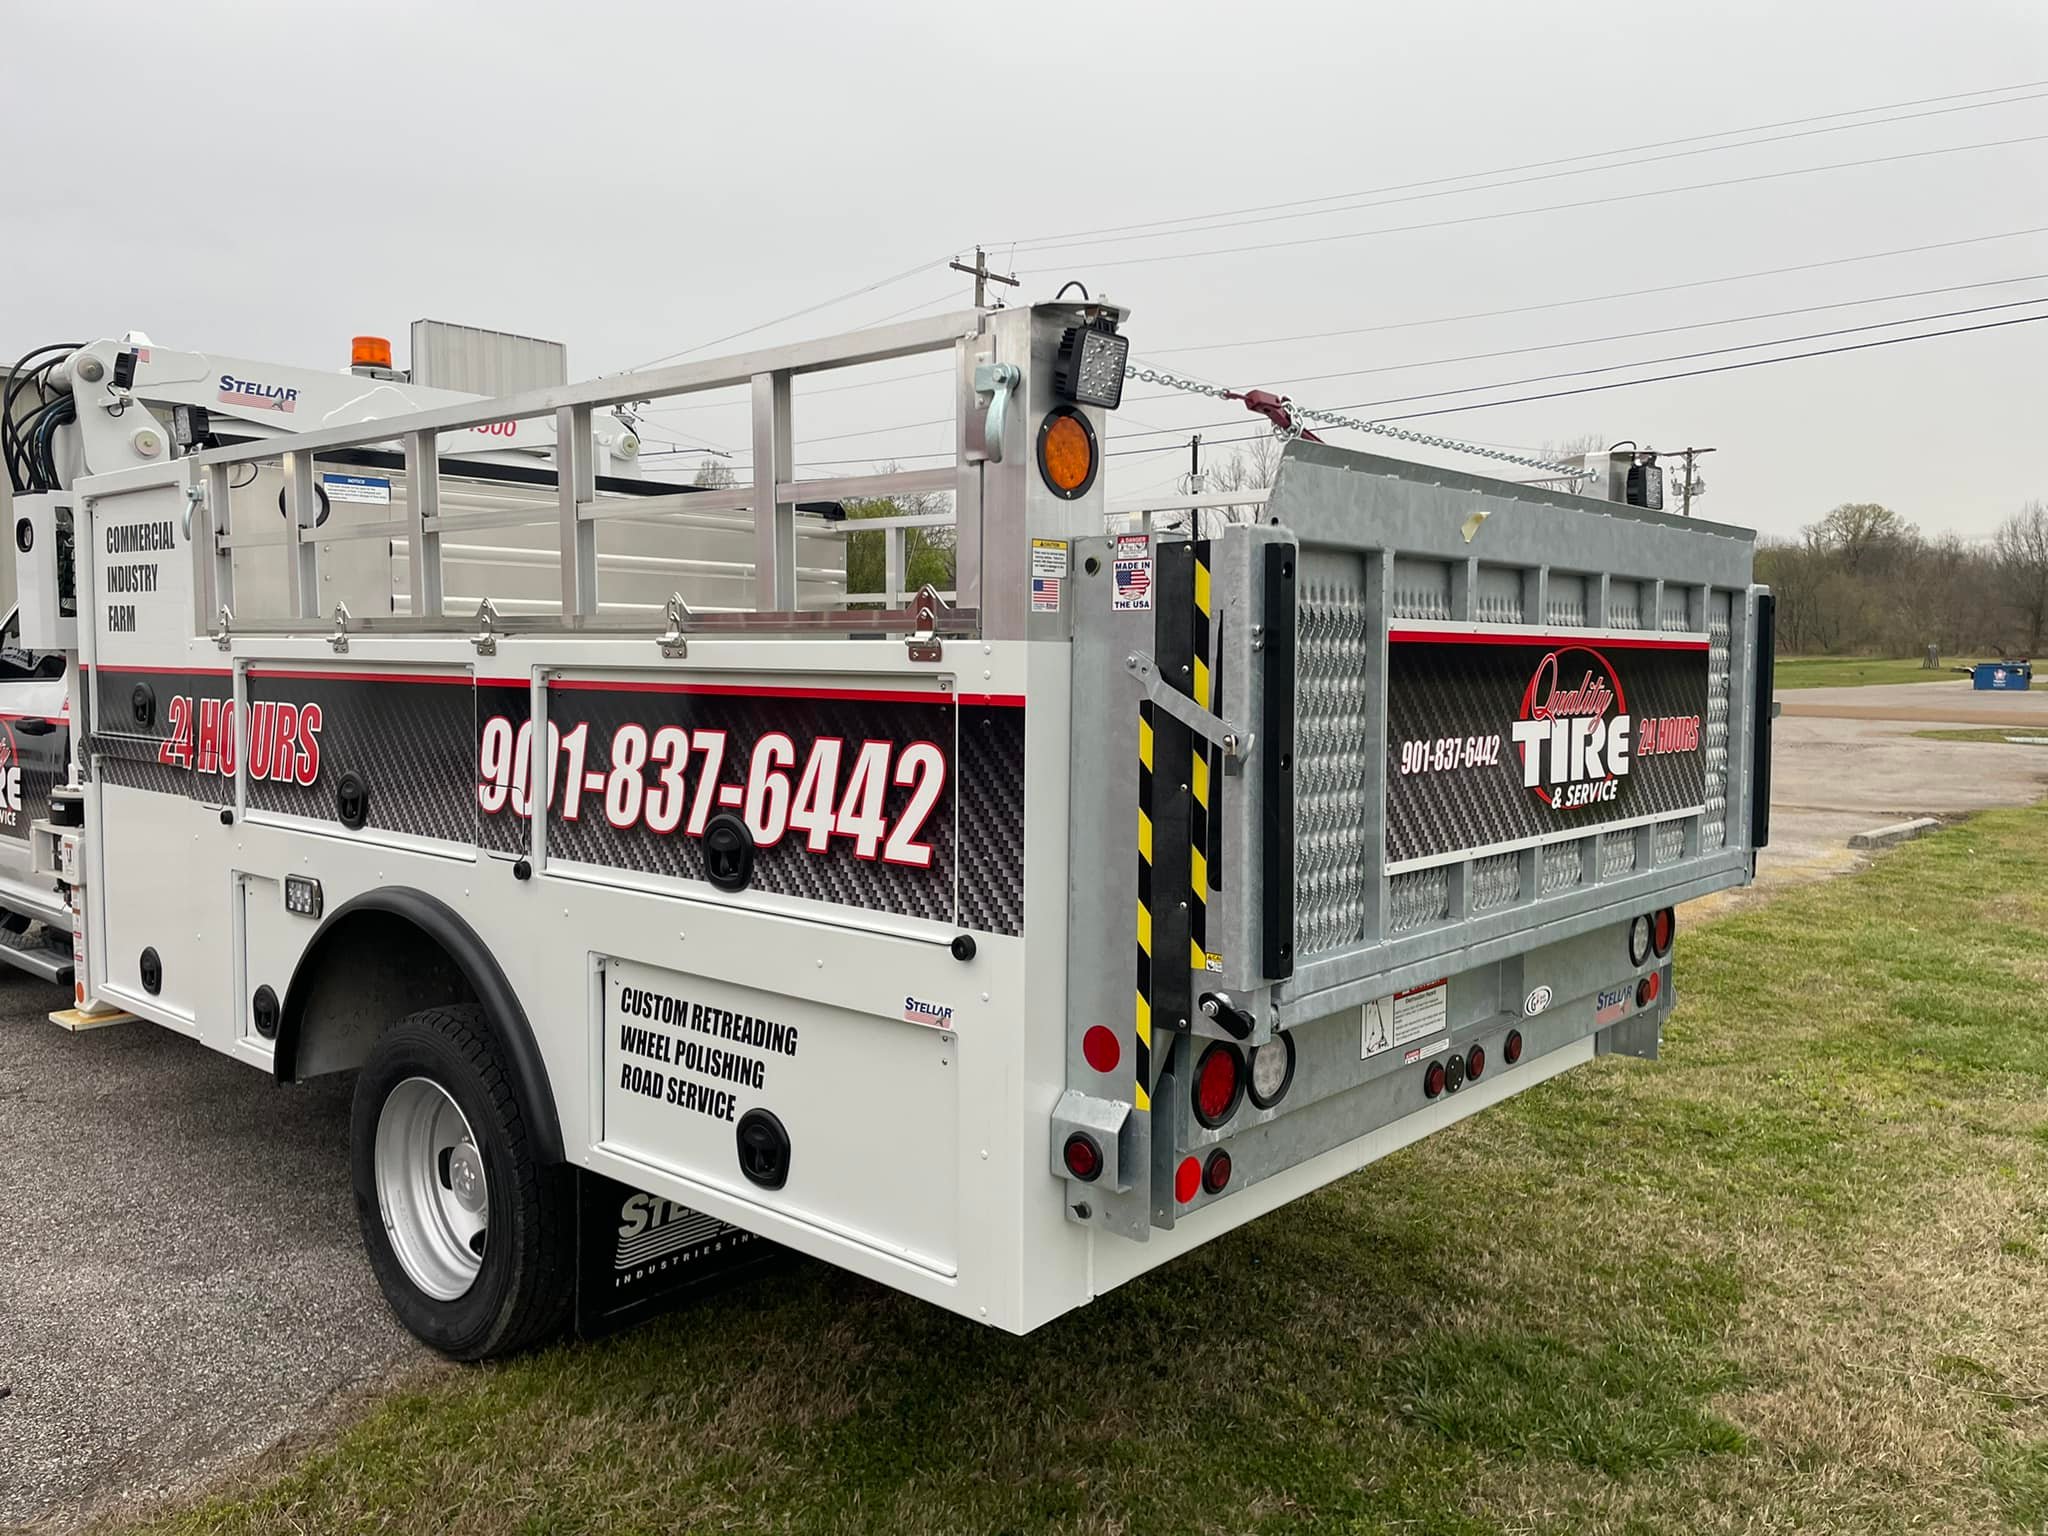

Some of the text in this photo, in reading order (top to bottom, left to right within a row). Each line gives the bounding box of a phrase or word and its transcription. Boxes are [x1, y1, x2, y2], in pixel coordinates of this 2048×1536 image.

[219, 375, 297, 401] STELLAR
[106, 521, 175, 554] COMMERCIAL
[107, 563, 158, 592] INDUSTRY
[1115, 561, 1150, 570] MADE IN
[108, 605, 136, 632] FARM
[1133, 600, 1149, 608] USA
[1532, 653, 1613, 733] Quality
[158, 695, 323, 786] 24 HOURS
[1401, 735, 1500, 775] 901-837-6442
[1512, 715, 1630, 788] TIRE
[1638, 715, 1699, 756] 24 HOURS
[479, 715, 946, 869] 901-837-6442
[1551, 780, 1617, 810] & SERVICE
[905, 996, 952, 1018] STELLAR
[1596, 985, 1632, 1011] STELLAR
[620, 987, 798, 1057] CUSTOM RETREADING
[620, 1024, 765, 1090] WHEEL POLISHING
[620, 1063, 737, 1123] ROAD SERVICE
[615, 1242, 722, 1287] INDUSTRIES
